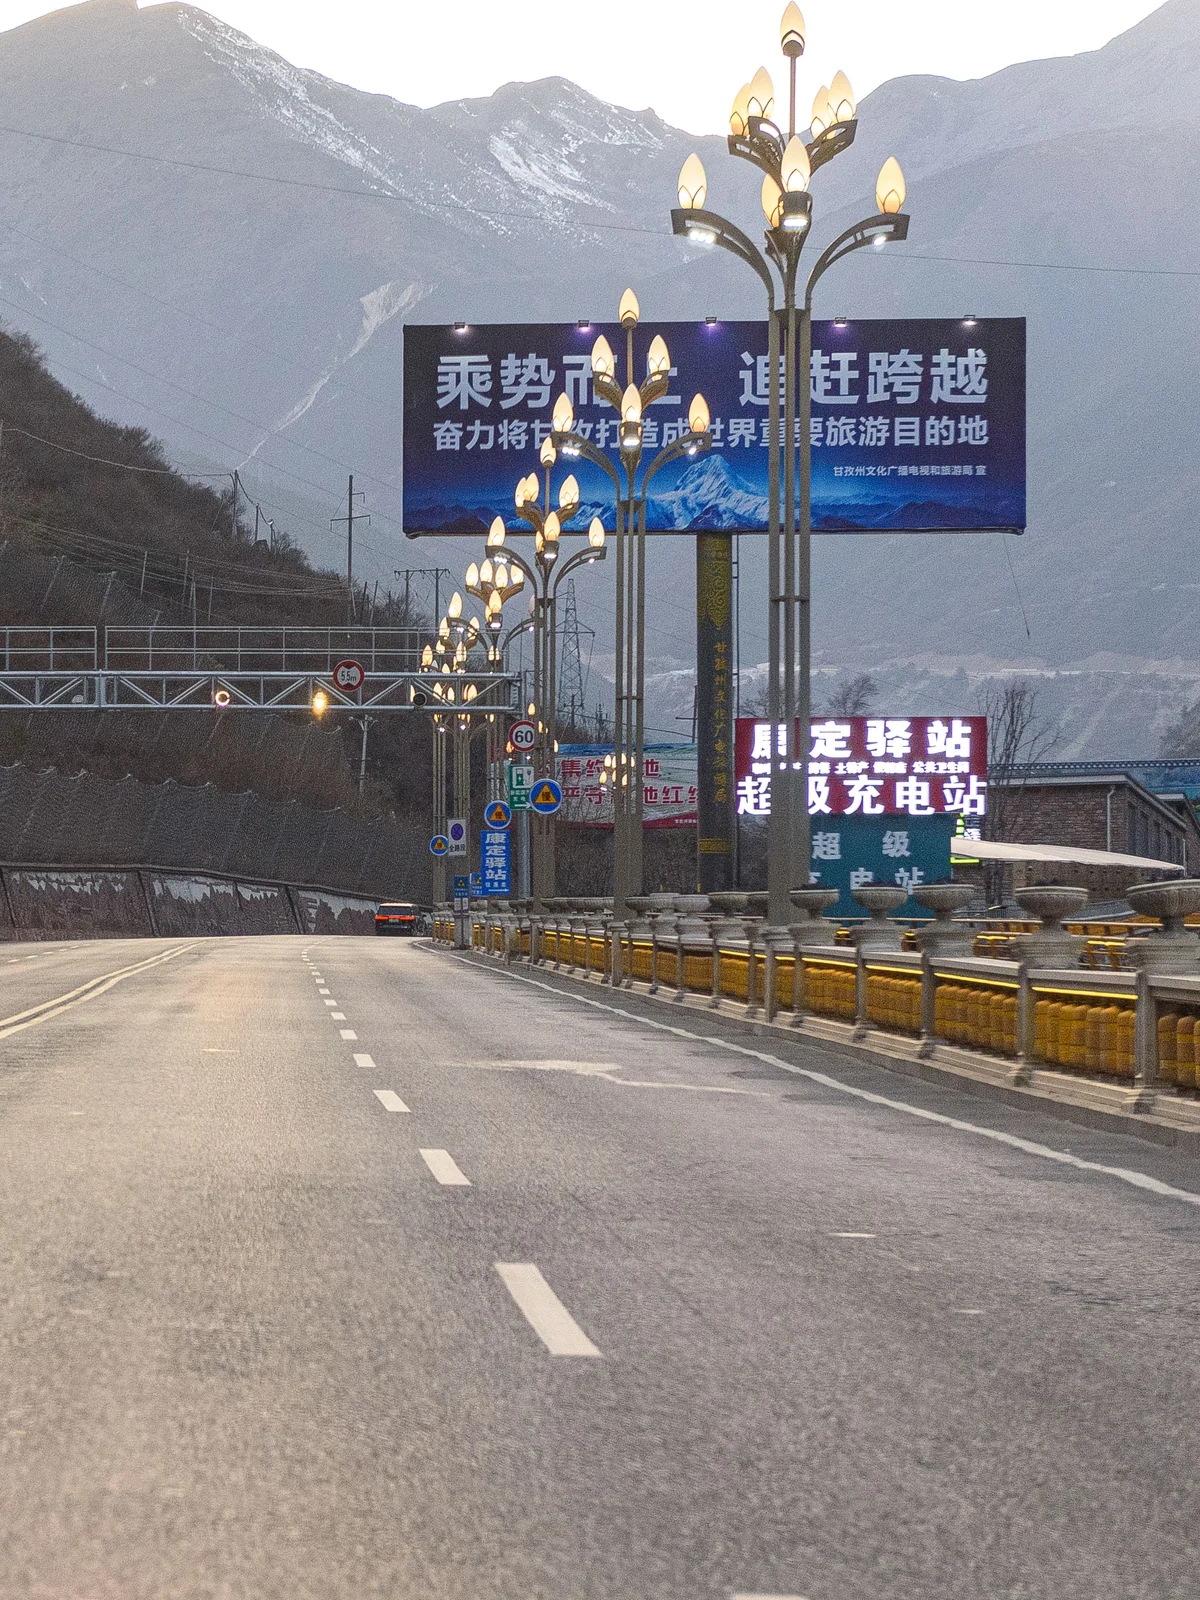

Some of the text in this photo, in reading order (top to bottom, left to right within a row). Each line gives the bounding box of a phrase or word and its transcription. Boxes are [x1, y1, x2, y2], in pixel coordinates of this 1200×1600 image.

[739, 349, 989, 406] 追赶跨越
[833, 465, 972, 477] 甘孜州文化广播电视和旅游局
[514, 730, 533, 743] 60
[751, 720, 971, 759] 康定驿站
[736, 774, 987, 815] 超级充电站
[485, 832, 507, 881] 康定驿站
